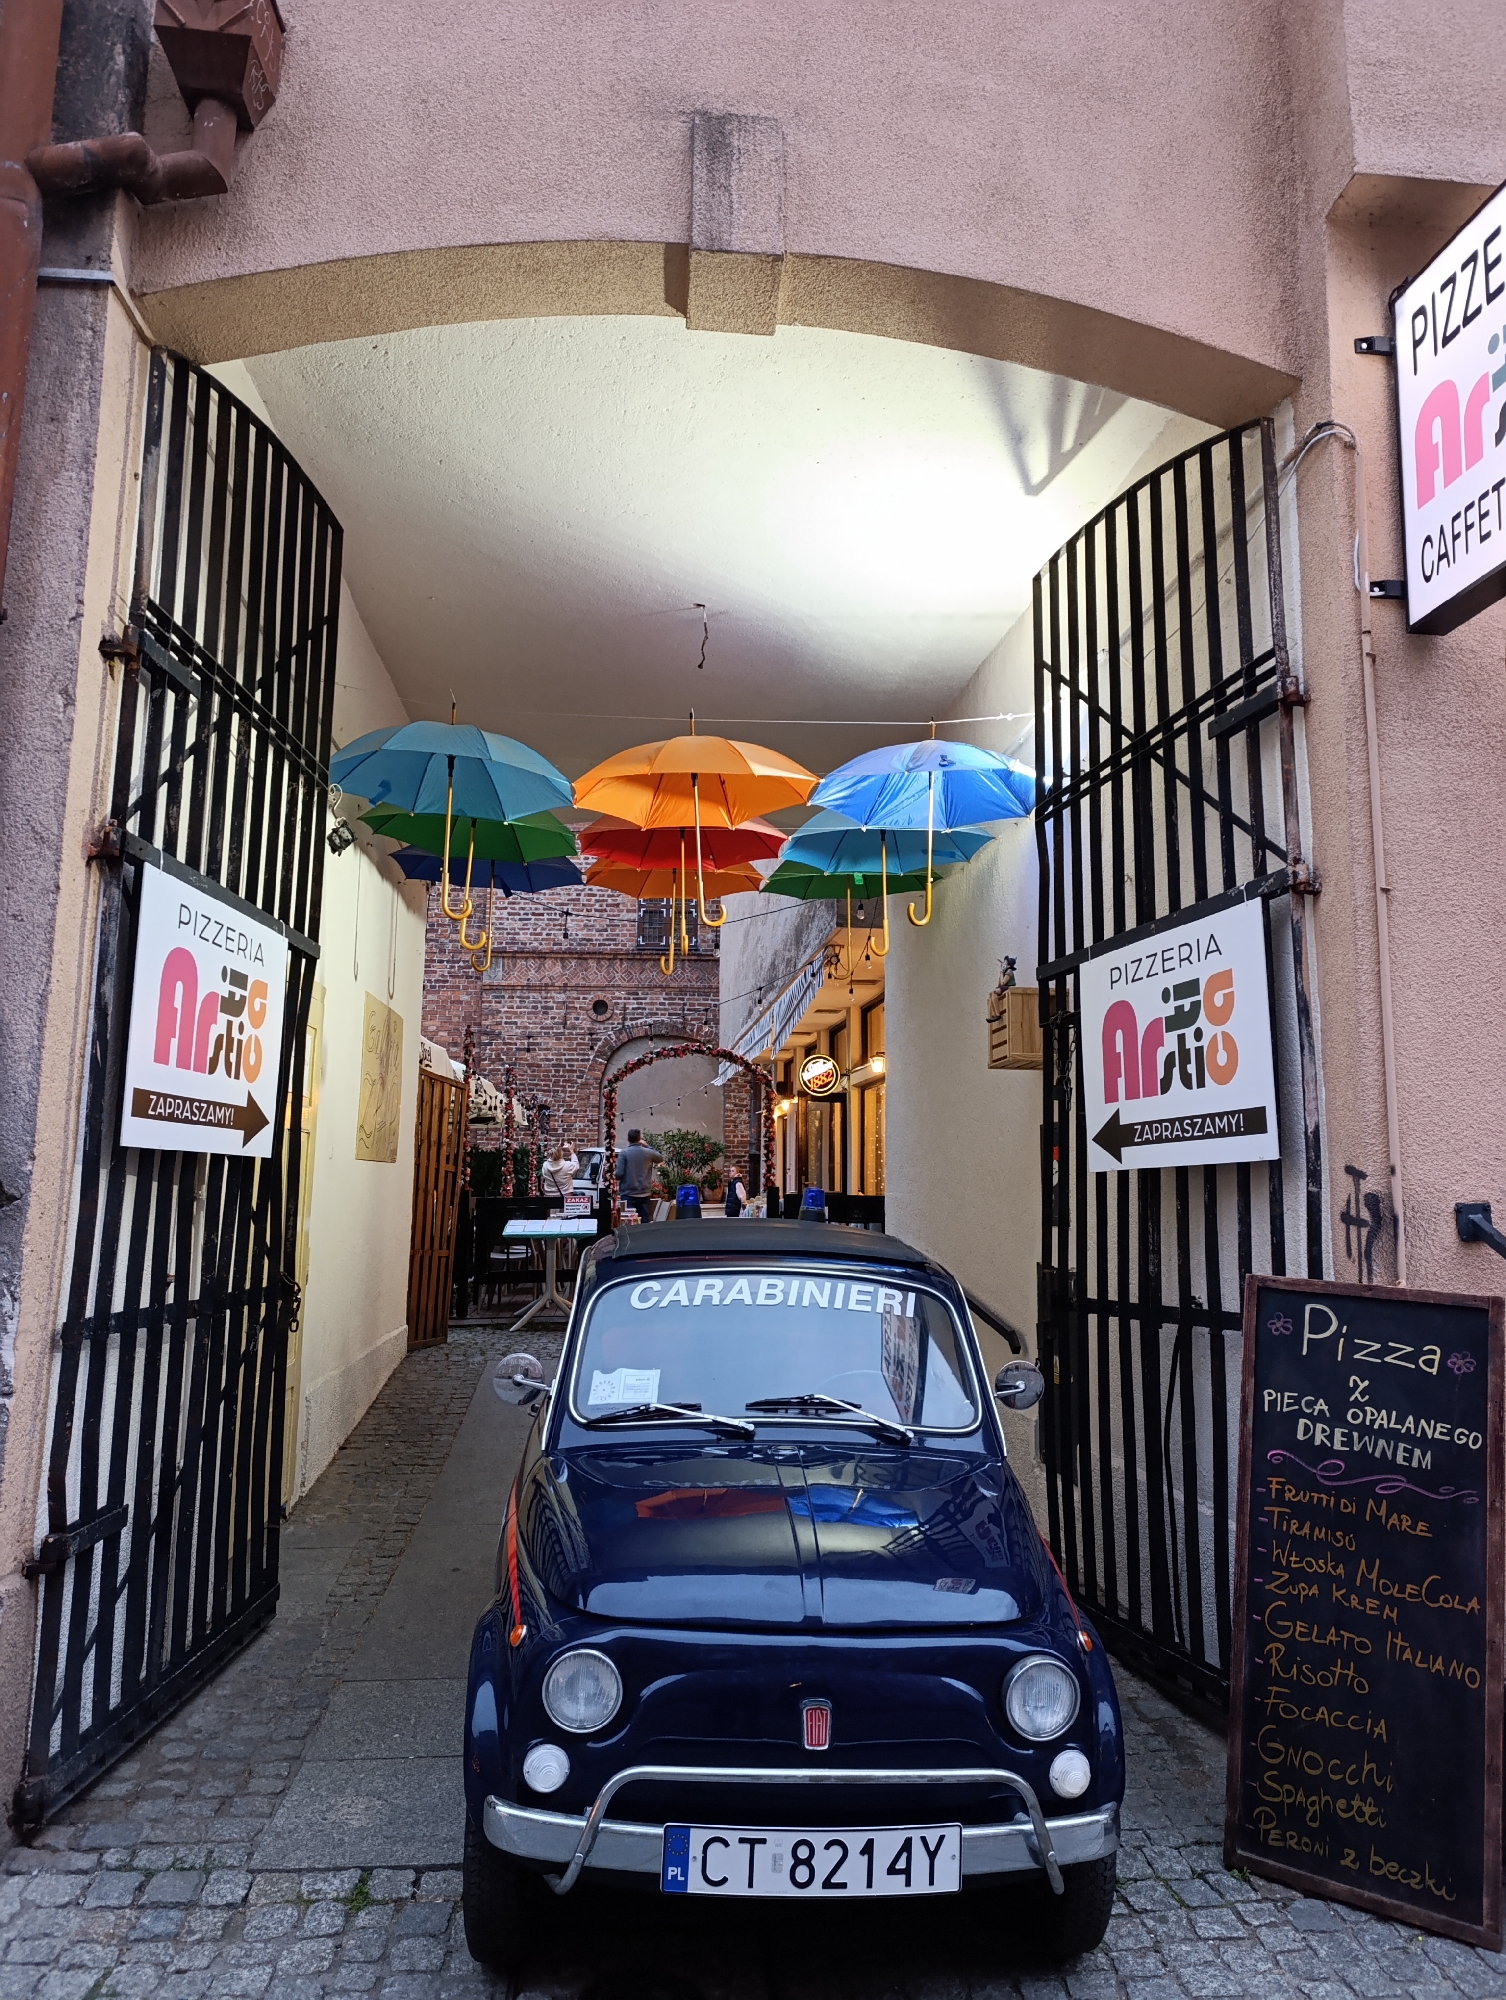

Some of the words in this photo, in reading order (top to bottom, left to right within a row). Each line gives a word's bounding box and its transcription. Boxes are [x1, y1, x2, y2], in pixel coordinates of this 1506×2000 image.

[178, 903, 265, 967] PIZZERIA
[1109, 933, 1223, 990] PIZZERIA
[810, 1069, 834, 1090] 1882
[147, 1094, 235, 1126] ZAPRASZAMY!
[1133, 1113, 1245, 1143] ZAPRASZAMY!
[629, 1278, 917, 1318] CARABINIERI
[1302, 1303, 1442, 1375] Pizza
[1263, 1389, 1331, 1418] PIECA
[1346, 1405, 1483, 1450] OPALANEGO
[1296, 1418, 1433, 1470] DREWNEM
[807, 1708, 829, 1746] FIAT
[667, 1866, 686, 1882] PL
[701, 1835, 768, 1889] CT
[788, 1833, 947, 1890] 8214Y
[1369, 1844, 1457, 1901] beczki
